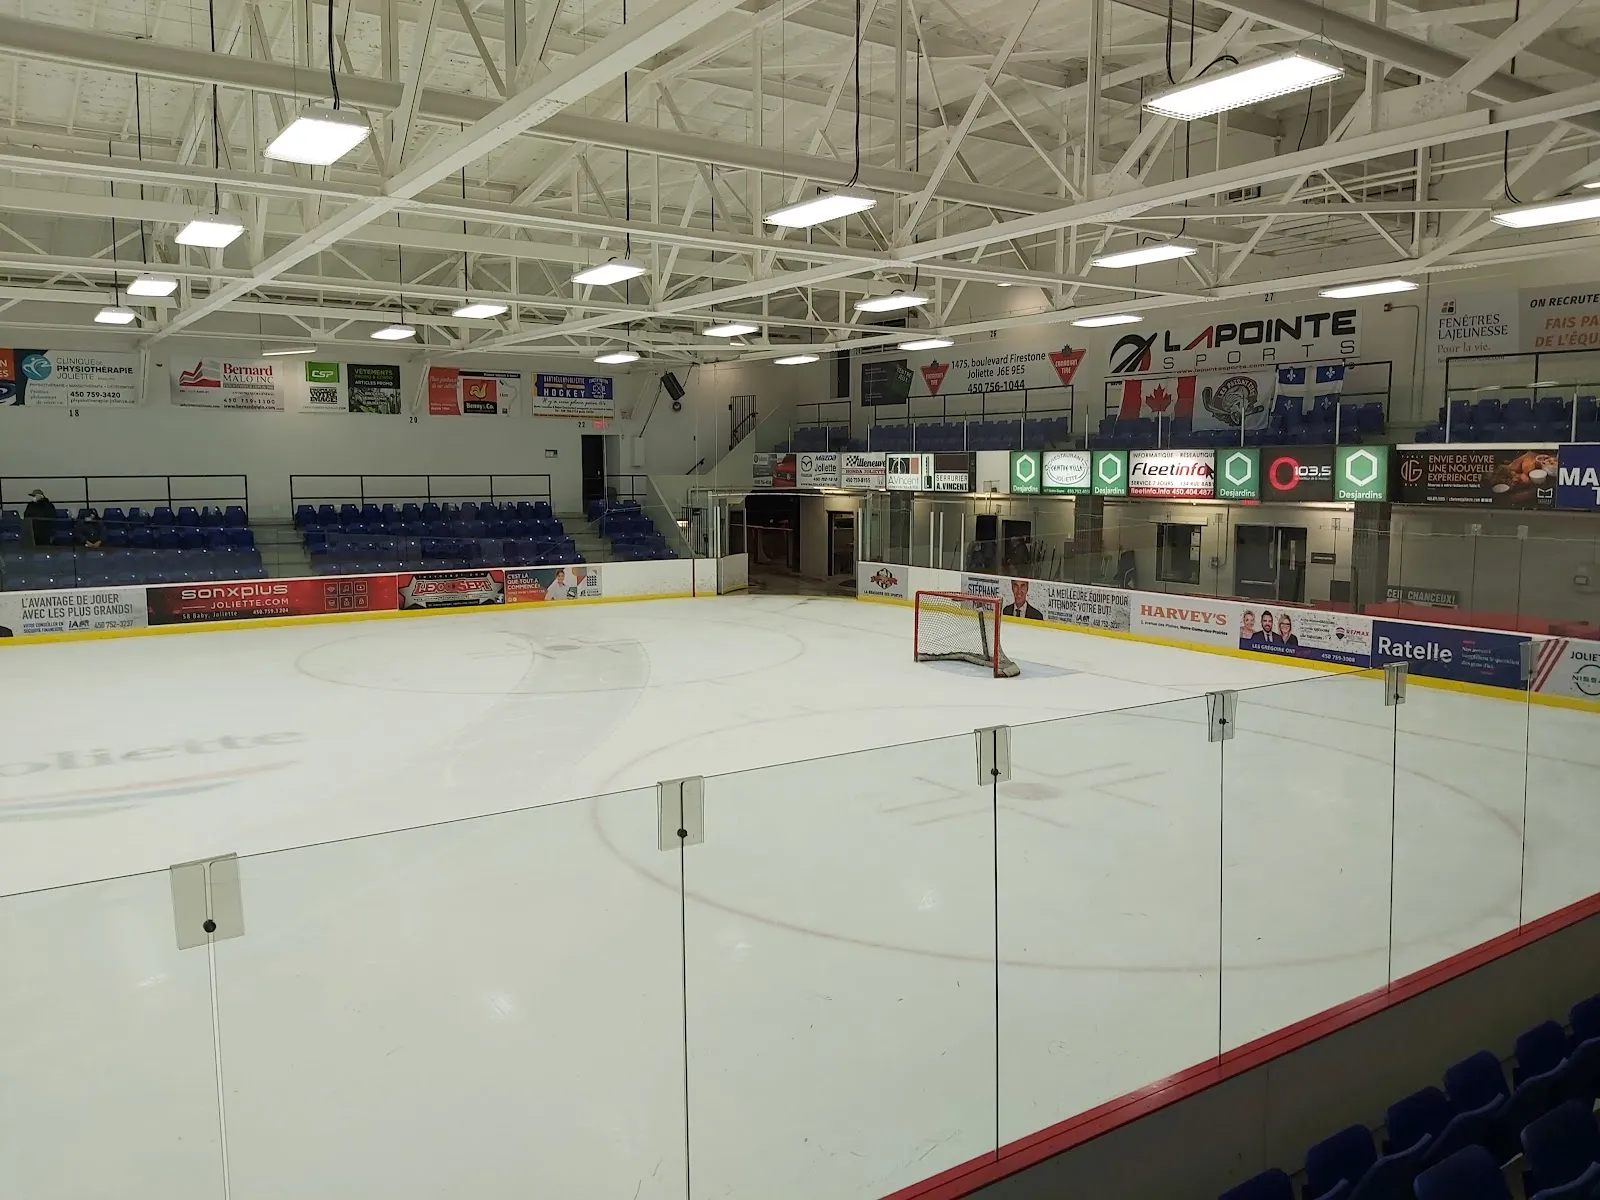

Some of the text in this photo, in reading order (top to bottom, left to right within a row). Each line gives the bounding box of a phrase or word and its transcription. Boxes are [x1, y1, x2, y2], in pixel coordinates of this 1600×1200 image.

[1265, 293, 1274, 302] 27
[1530, 299, 1546, 308] ON
[1439, 313, 1500, 328] FENÊTRES
[1545, 317, 1576, 329] FAIS
[1164, 309, 1357, 352] LAPOINTE
[1438, 325, 1508, 341] LAJEUNESSE
[1535, 336, 1554, 347] DE
[1437, 344, 1459, 354] Pour
[951, 352, 1046, 369] 1475, boulevard Firestone
[1163, 340, 1355, 370] SPORTS
[223, 363, 273, 376] Bernard
[312, 370, 334, 378] CSP
[967, 365, 1025, 379] Joliette J6E 9E5
[223, 375, 274, 384] MALO INC
[968, 380, 1025, 392] 450 756-1044
[543, 388, 586, 398] HOCKEY
[1428, 455, 1494, 464] ENVIE DE VIVRE
[814, 463, 837, 472] Joliette
[1428, 464, 1494, 473] UNE NOUVELLE
[936, 482, 968, 490] A.VINCENT
[1012, 485, 1038, 493] Desjardins
[1095, 486, 1124, 495] Desjardins
[1130, 487, 1171, 495] fleetinfo.info
[1220, 488, 1256, 497] Desjardins
[1338, 490, 1383, 500] Desjardins
[181, 584, 288, 600] sonxplus
[967, 583, 999, 596] STÉPHANE
[21, 593, 119, 609] L'AVANTAGE DE JOUER
[1048, 588, 1055, 598] LA
[1056, 588, 1087, 602] MEILLEURE
[1111, 594, 1129, 606] POUR
[210, 598, 289, 609] JOLIETTE.COM
[22, 604, 133, 619] AVEC LES PLUS GRANDS!
[1140, 604, 1227, 626] HARVEY'S
[1378, 636, 1453, 663] Ratelle
[1572, 674, 1600, 684] NISS
